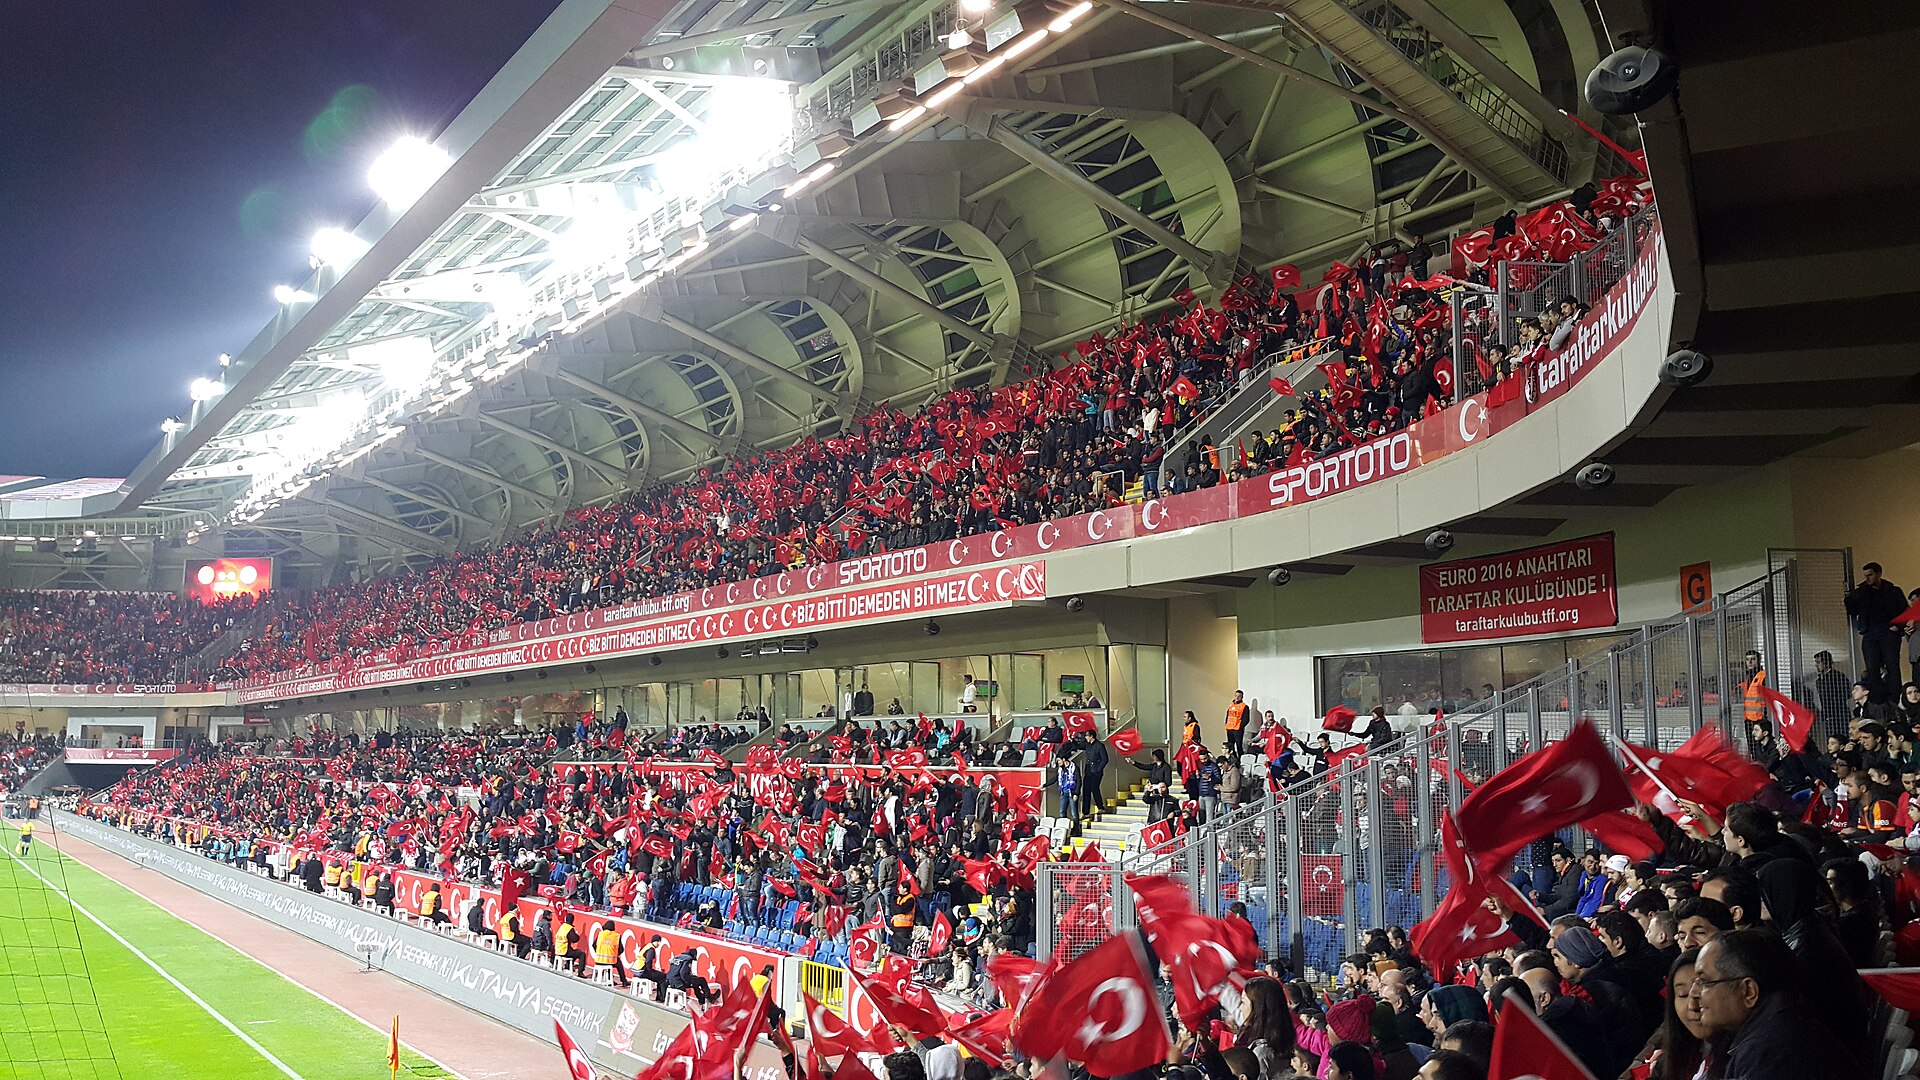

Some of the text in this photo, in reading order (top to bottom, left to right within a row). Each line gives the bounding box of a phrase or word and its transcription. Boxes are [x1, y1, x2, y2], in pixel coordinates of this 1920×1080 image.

[1269, 432, 1411, 506] SPORTOTO
[840, 547, 927, 585] SPORTOTO
[1439, 548, 1592, 588] EURO 2016 ANAHTARI
[797, 580, 967, 624] BİZ BİTTİ DEMEDEN BİTMEZ
[1428, 591, 1502, 614] TARAFTAR
[1505, 573, 1597, 607] KULÜBÜNDE
[1687, 572, 1706, 605] G
[603, 596, 690, 623] taraftarkulubu.tff.org
[1455, 607, 1579, 633] taraftarkulubu.tff.org
[589, 637, 601, 653] BİZ
[620, 627, 657, 649] DEMEDEN
[659, 622, 689, 642] BİTMEZ
[133, 684, 177, 693] SPORTOTO
